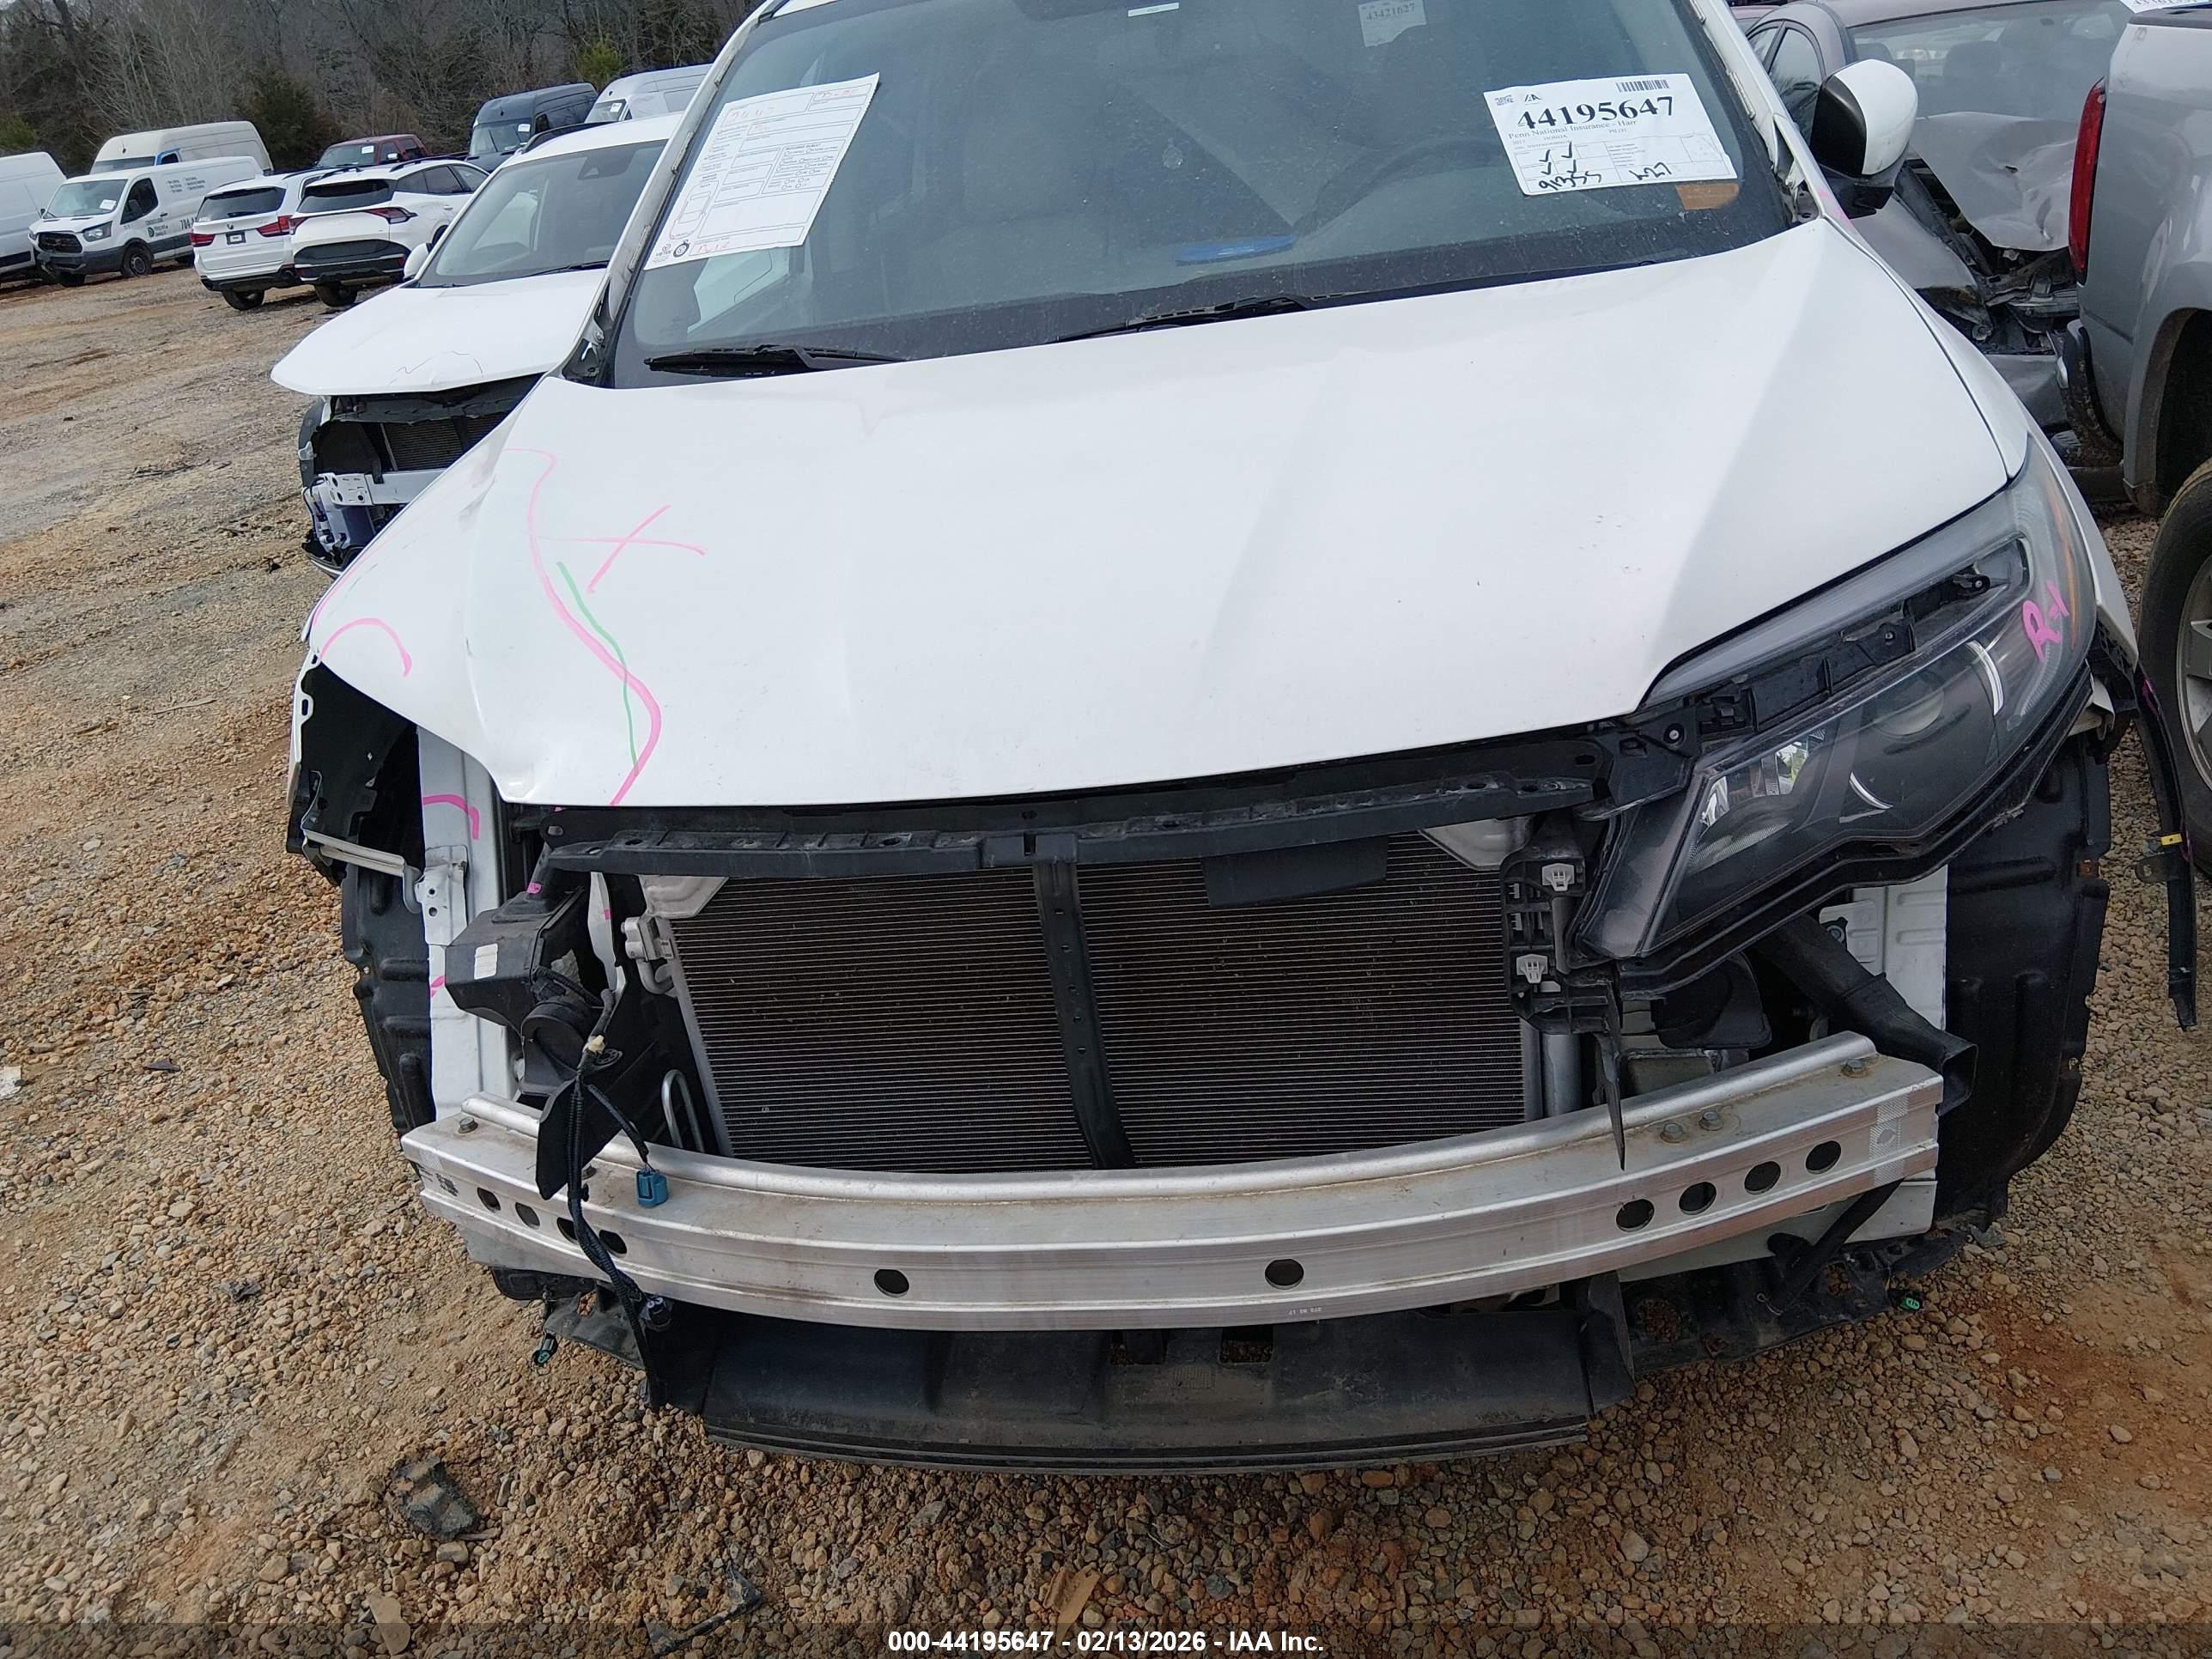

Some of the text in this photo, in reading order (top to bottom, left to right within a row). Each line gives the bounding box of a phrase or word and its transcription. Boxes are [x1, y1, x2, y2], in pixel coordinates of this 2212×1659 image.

[1517, 95, 1674, 130] 44195647
[1531, 126, 1568, 136] National
[1570, 121, 1610, 131] Insurance
